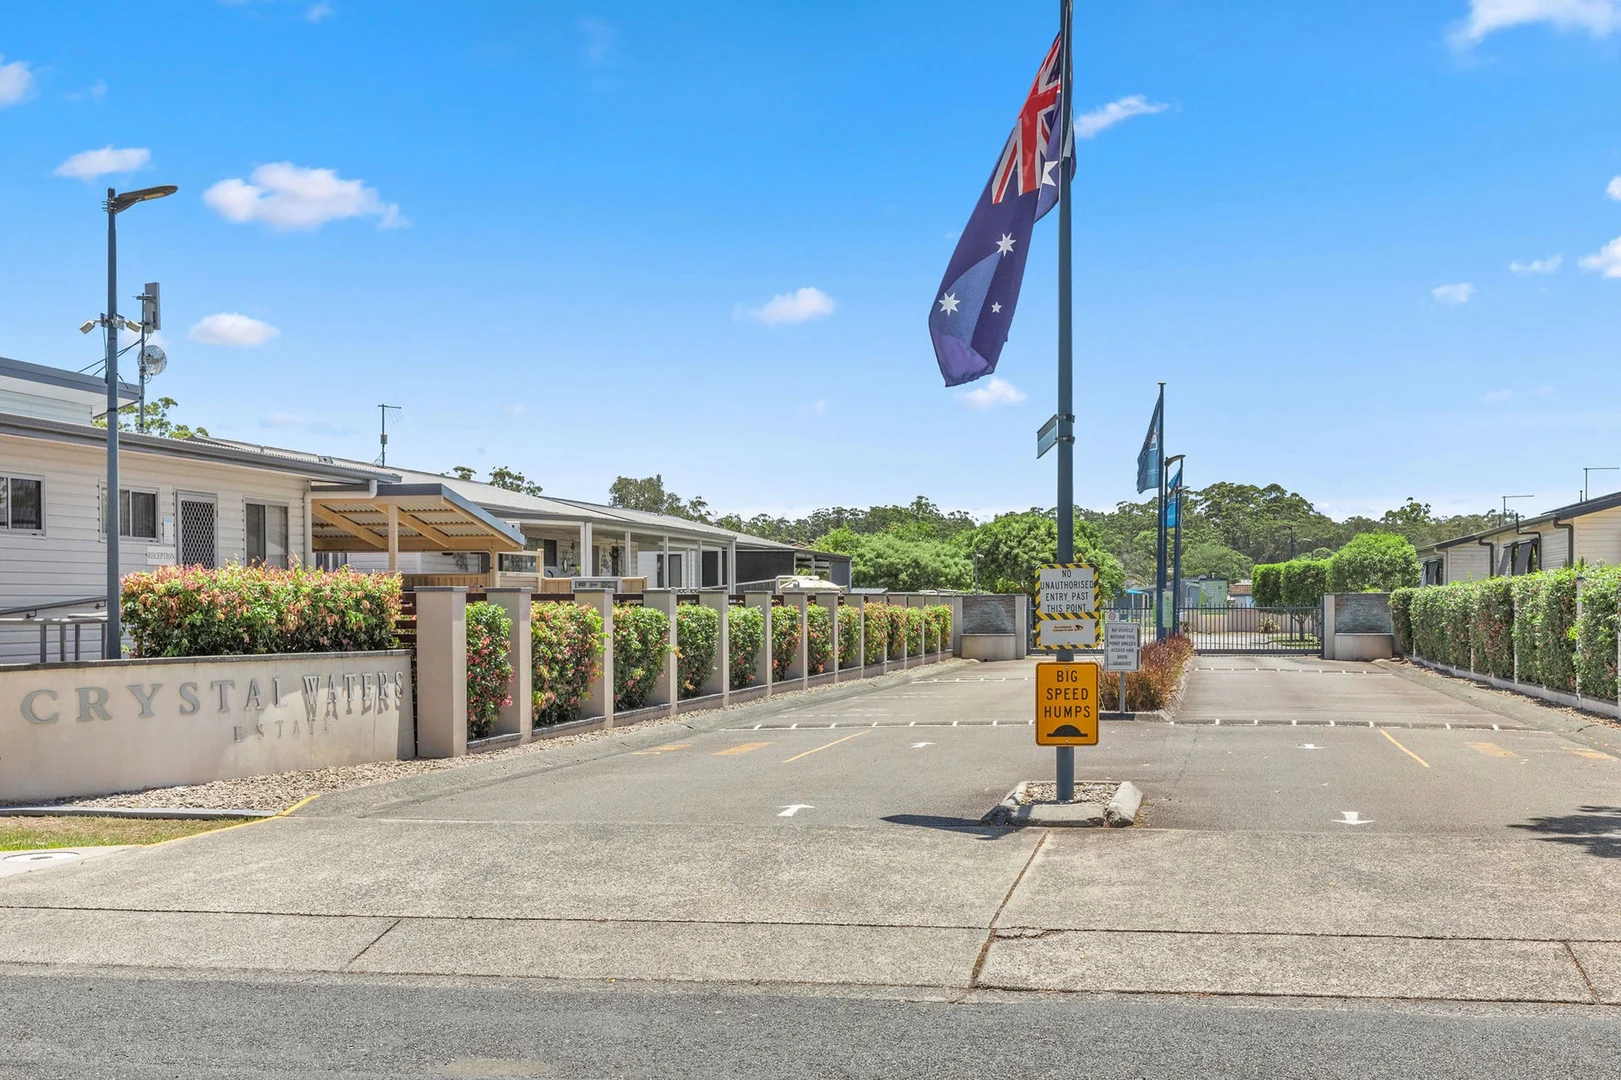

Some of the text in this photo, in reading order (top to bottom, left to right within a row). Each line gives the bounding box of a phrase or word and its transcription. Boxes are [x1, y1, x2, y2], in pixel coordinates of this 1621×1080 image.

[1062, 570, 1072, 578] NO
[1040, 580, 1094, 590] UNAUTHORISED
[1046, 592, 1088, 601] ENTRY PAST
[1047, 604, 1090, 612] THIS POINT.
[1056, 670, 1078, 682] BIG
[20, 671, 403, 724] CRYSTAL WATERS
[1046, 688, 1088, 700] SPEED
[1044, 706, 1090, 718] HUMPS
